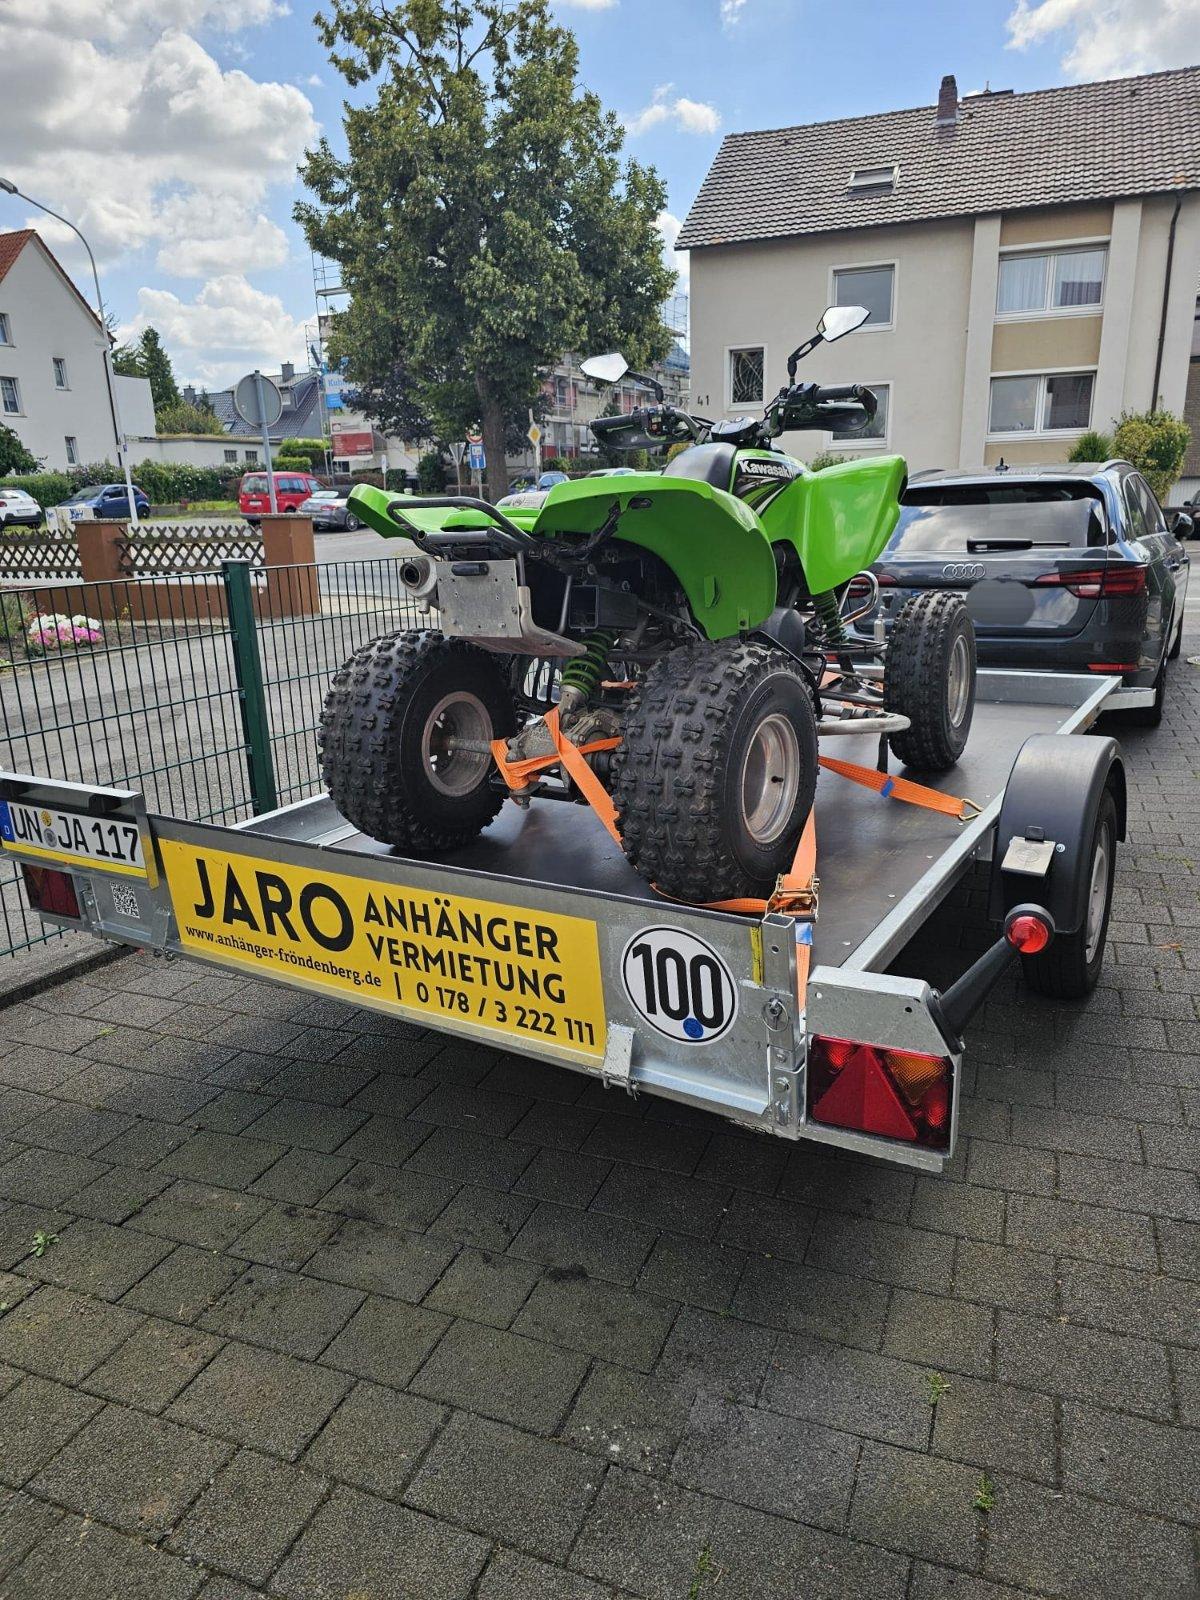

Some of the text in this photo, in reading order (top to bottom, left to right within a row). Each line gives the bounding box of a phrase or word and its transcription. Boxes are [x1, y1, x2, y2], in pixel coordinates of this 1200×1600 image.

[697, 394, 710, 406] 41
[740, 460, 795, 478] Kawasaki
[10, 806, 138, 862] UN JA 117
[193, 858, 354, 952] JARO
[363, 893, 560, 963] ANHÄNGER
[185, 925, 382, 988] www.anhänger-fröndenberg.de
[366, 932, 567, 1004] VERMIETUNG
[632, 943, 725, 1029] 100
[416, 982, 429, 1004] 0
[435, 986, 470, 1015] 178
[495, 1000, 508, 1024] 3
[515, 1005, 557, 1036] 222
[563, 1017, 596, 1046] 111
